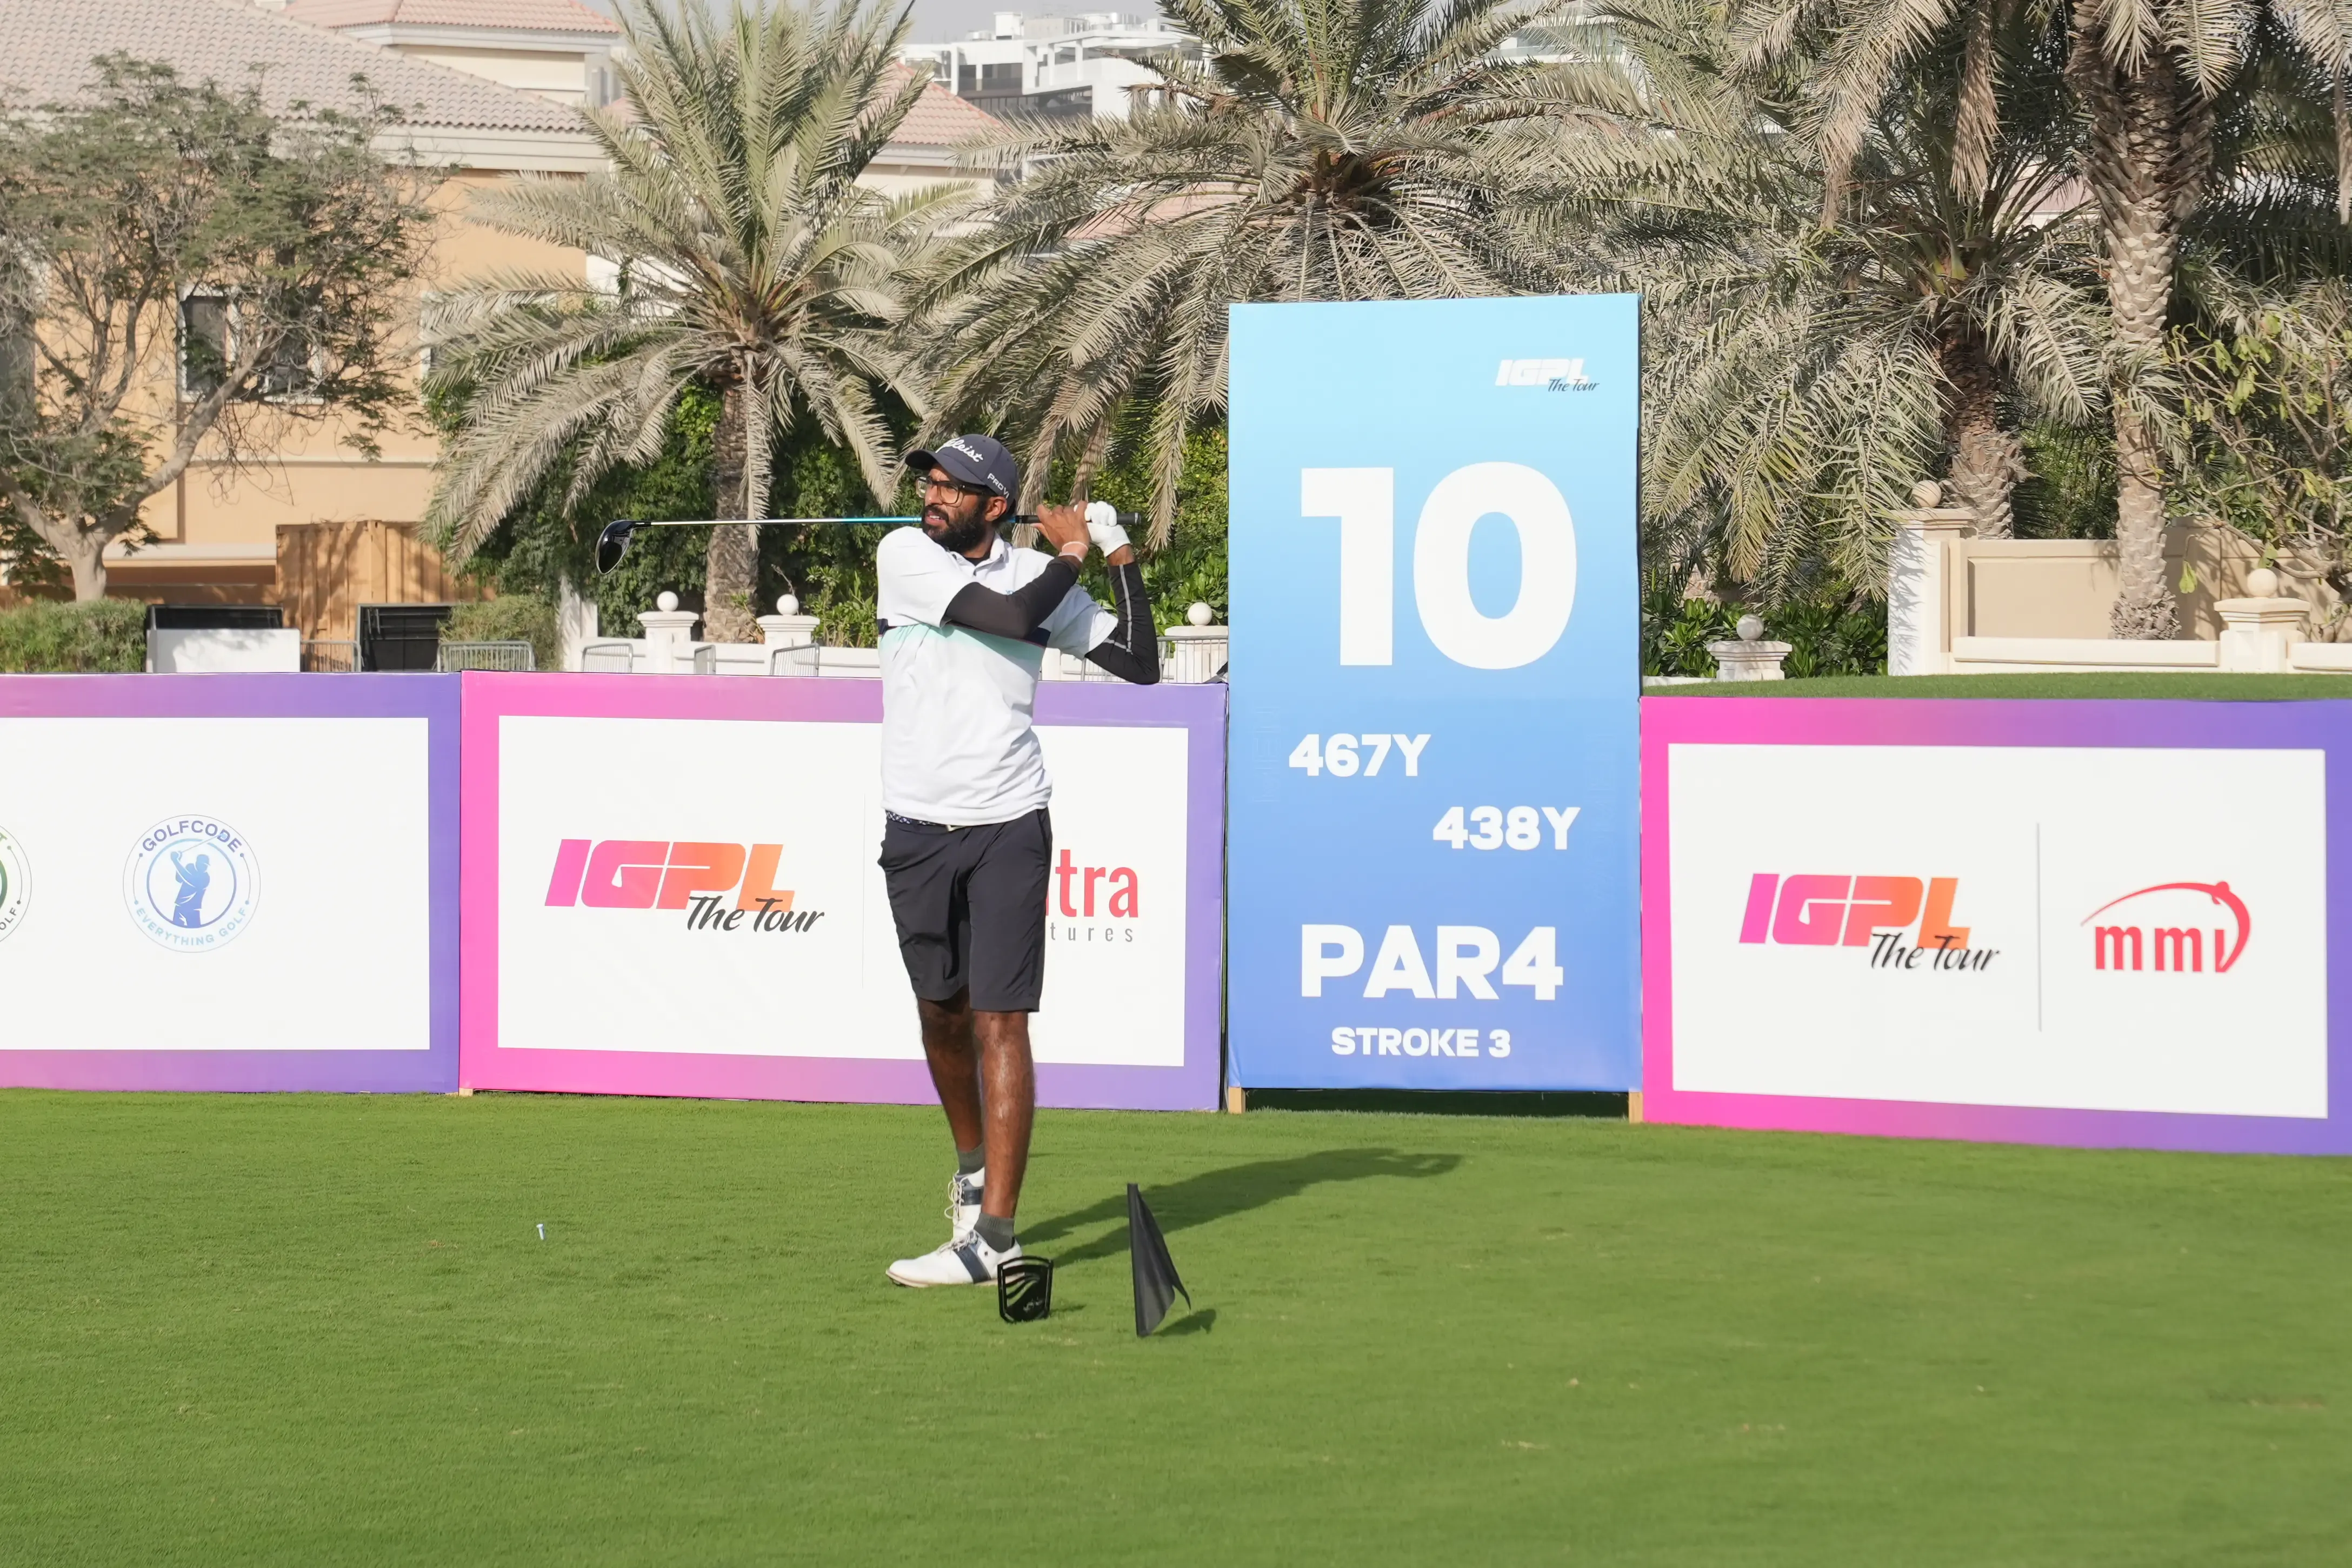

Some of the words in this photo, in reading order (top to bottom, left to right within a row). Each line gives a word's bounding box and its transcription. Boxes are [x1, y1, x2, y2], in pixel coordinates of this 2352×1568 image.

[1495, 358, 1589, 385] IGPL
[1548, 378, 1570, 391] The
[1572, 378, 1600, 391] Tour
[1301, 461, 1577, 670] 10
[1289, 733, 1431, 777] 467Y
[142, 820, 242, 853] GOLFCODE
[1432, 805, 1581, 850] 438Y
[544, 839, 795, 912] IGPL
[1045, 849, 1138, 918] tra
[0, 907, 17, 931] OLF
[136, 908, 215, 946] EVERYTHING
[218, 908, 247, 937] GOLF
[687, 895, 745, 931] The
[753, 897, 825, 933] Tour
[1739, 873, 1971, 950] IGPL
[1050, 922, 1133, 942] tures
[1302, 924, 1563, 1000] PAR4
[1870, 932, 1924, 970] The
[1933, 935, 2000, 971] Tour
[1331, 1027, 1479, 1058] STROKE
[1488, 1029, 1511, 1058] 3
